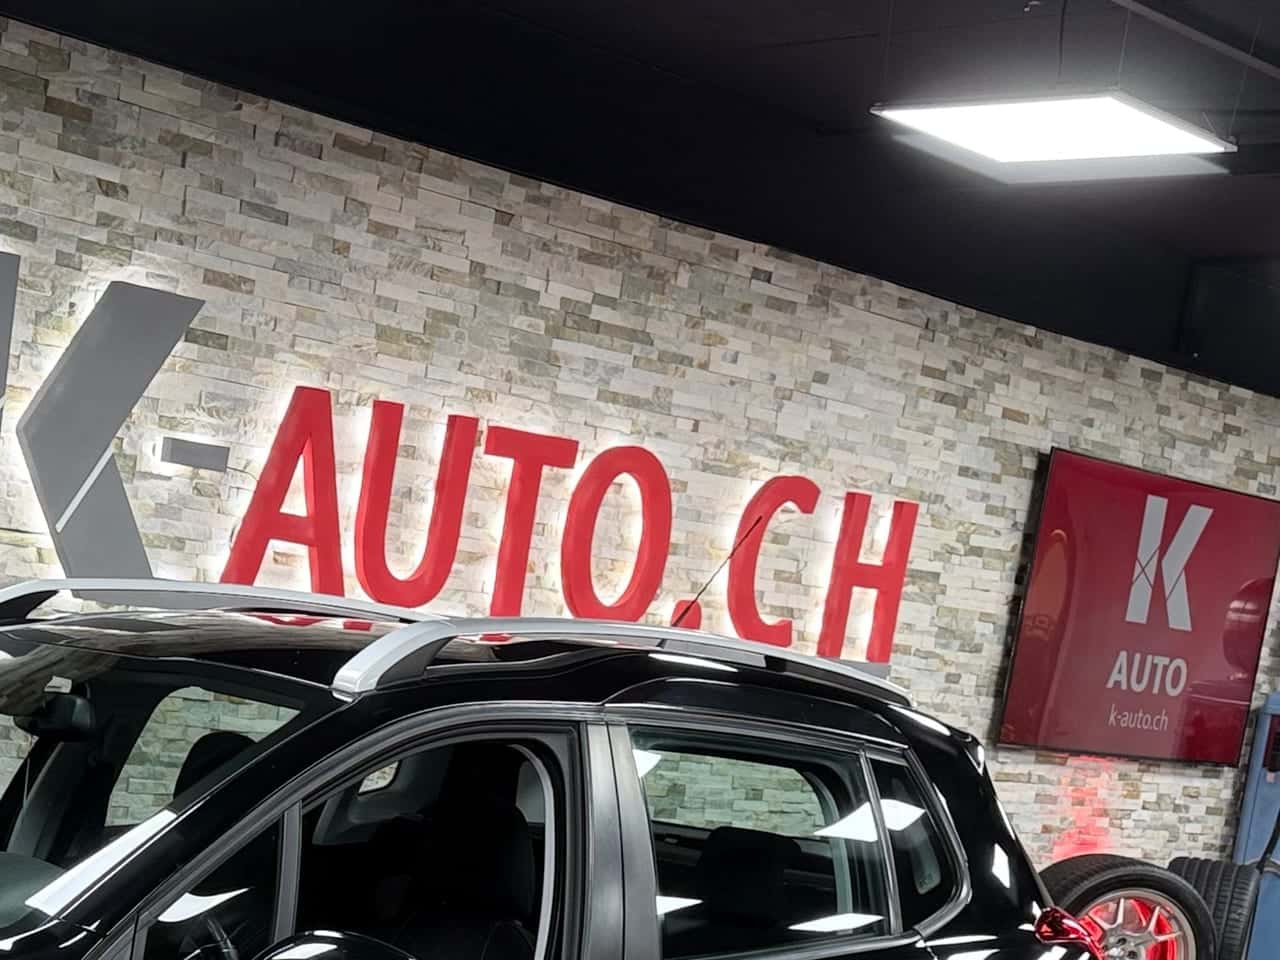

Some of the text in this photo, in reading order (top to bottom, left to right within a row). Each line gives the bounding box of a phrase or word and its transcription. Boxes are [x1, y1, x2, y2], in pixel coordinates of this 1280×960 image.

[1125, 494, 1214, 632] K
[1106, 651, 1188, 697] AUTO
[1108, 704, 1169, 736] k-auto.ch
